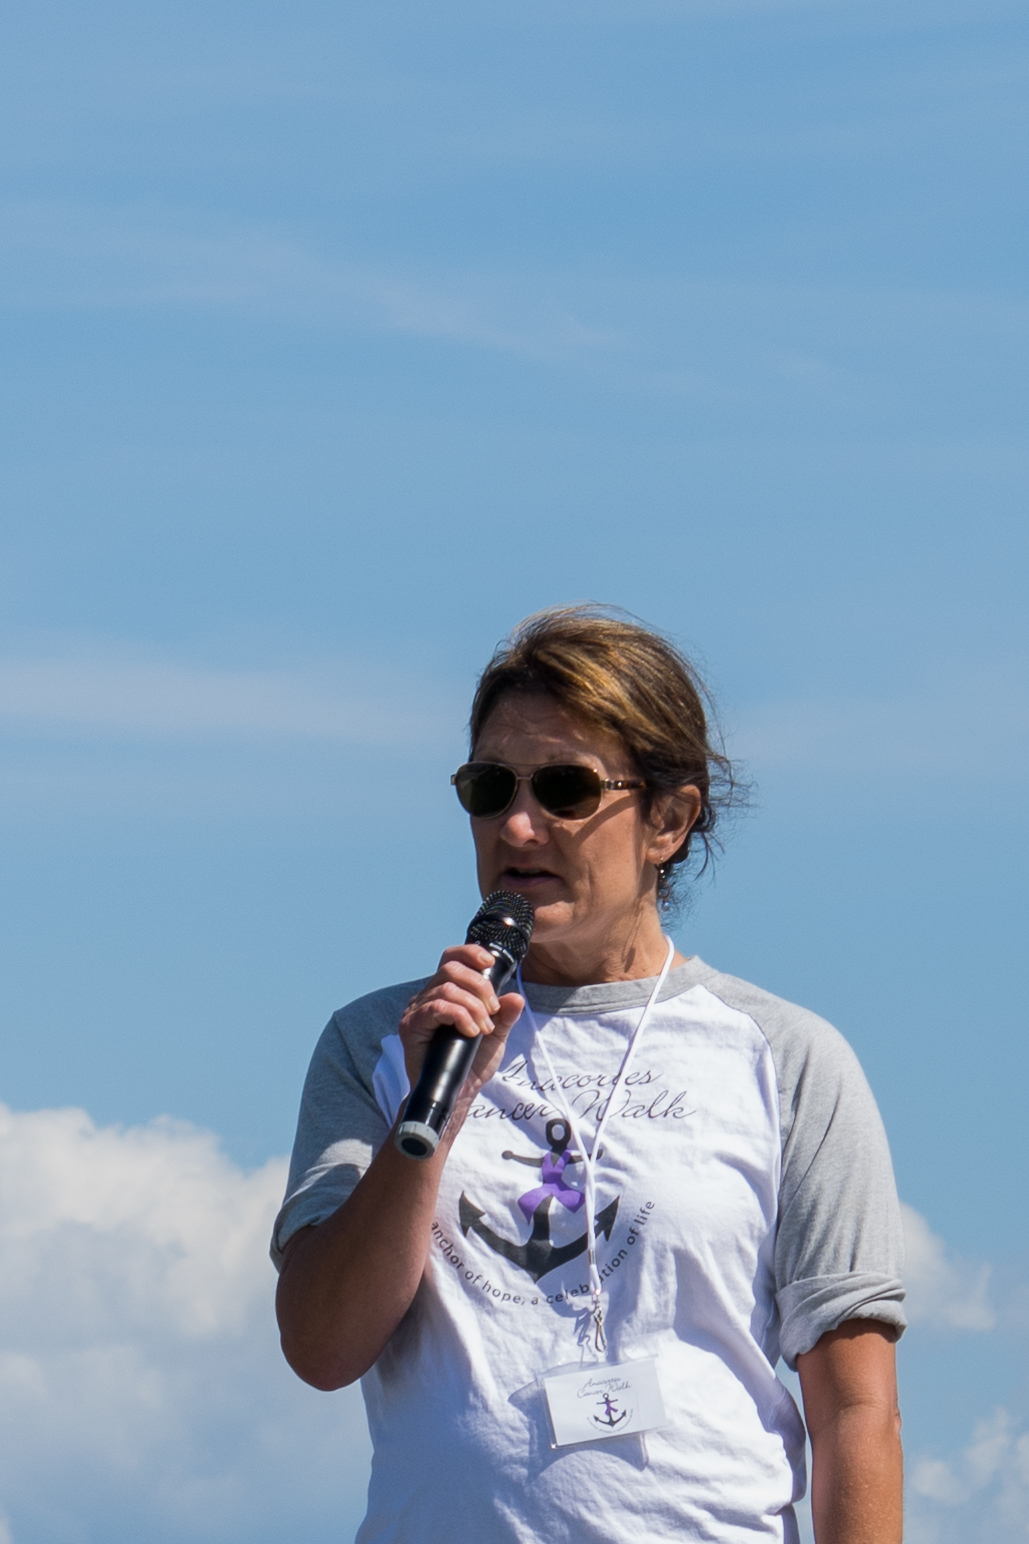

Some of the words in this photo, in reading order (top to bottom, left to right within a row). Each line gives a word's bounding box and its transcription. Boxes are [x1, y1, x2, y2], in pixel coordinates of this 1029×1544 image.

[467, 1102, 556, 1120] ancer
[572, 1089, 696, 1121] Walk
[633, 1200, 655, 1226] life
[431, 1222, 464, 1269] anchor
[626, 1227, 641, 1245] of
[465, 1271, 483, 1284] of
[546, 1249, 627, 1304] celebtion
[481, 1280, 526, 1305] hope,
[531, 1297, 539, 1305] a
